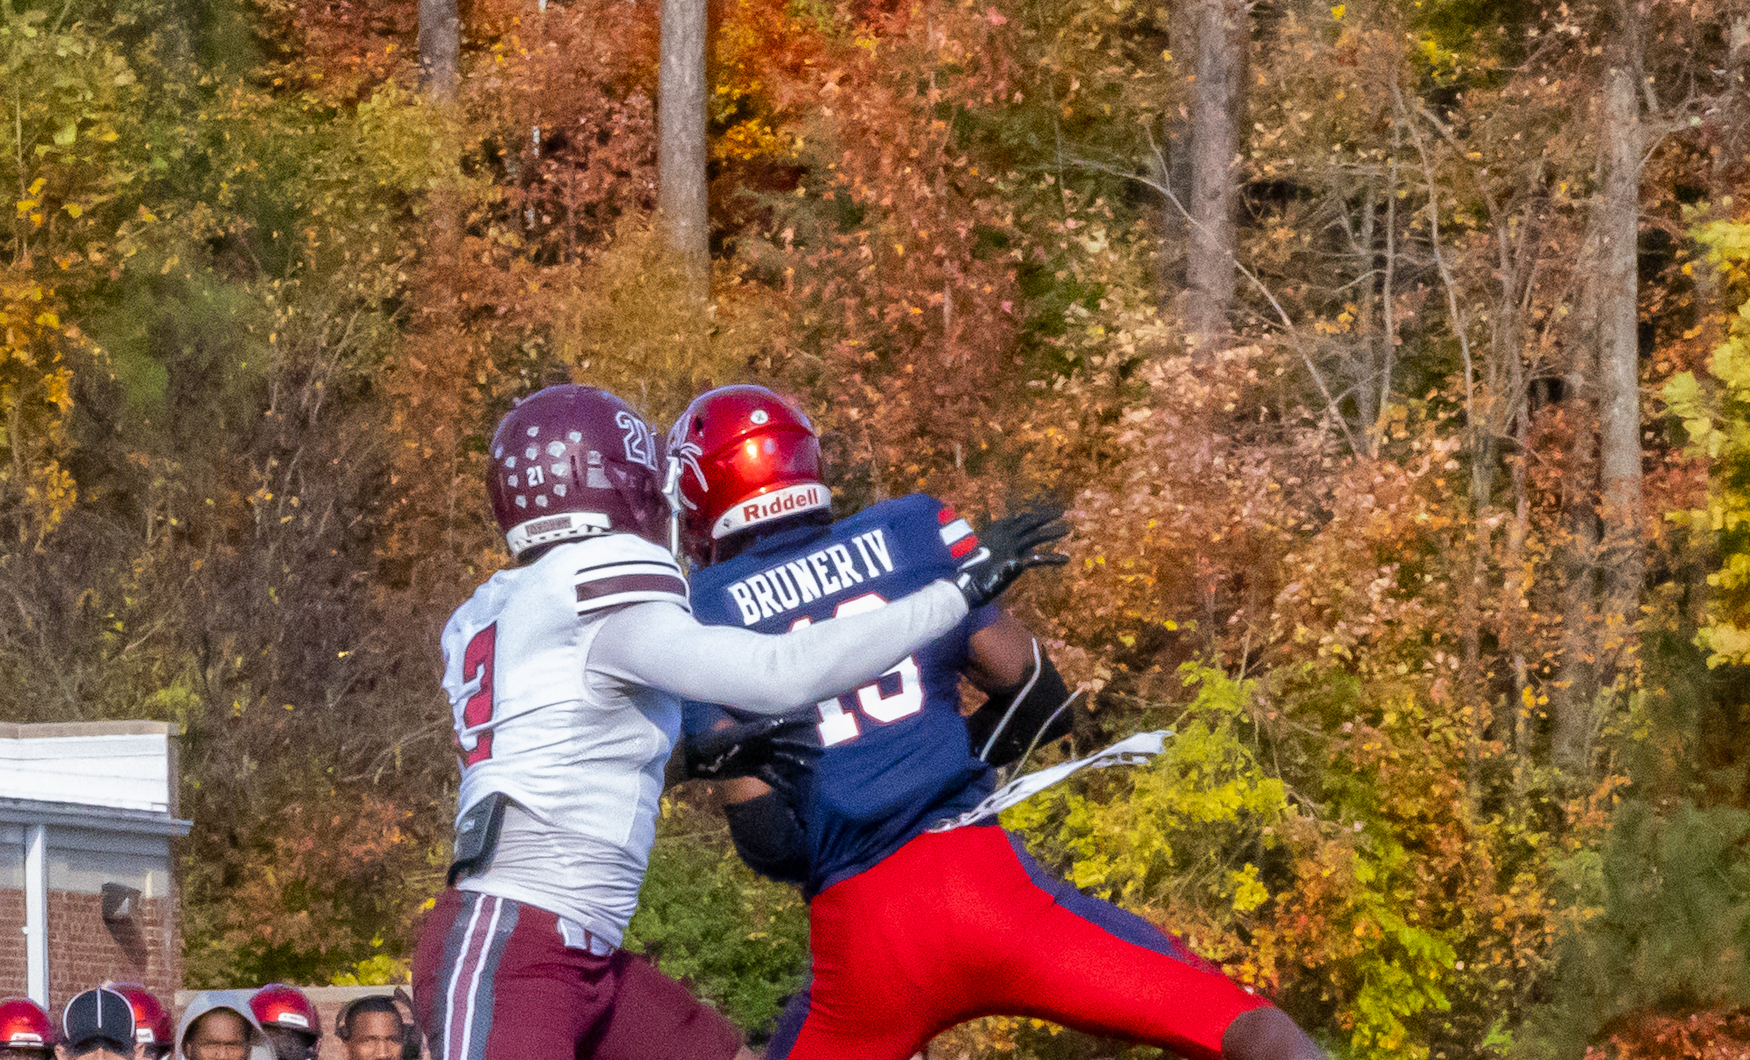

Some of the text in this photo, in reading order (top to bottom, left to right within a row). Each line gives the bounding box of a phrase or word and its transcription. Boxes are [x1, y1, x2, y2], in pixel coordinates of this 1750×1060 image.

[526, 465, 545, 488] 21
[743, 488, 819, 522] Riddell
[728, 528, 895, 626] BRUNER IV
